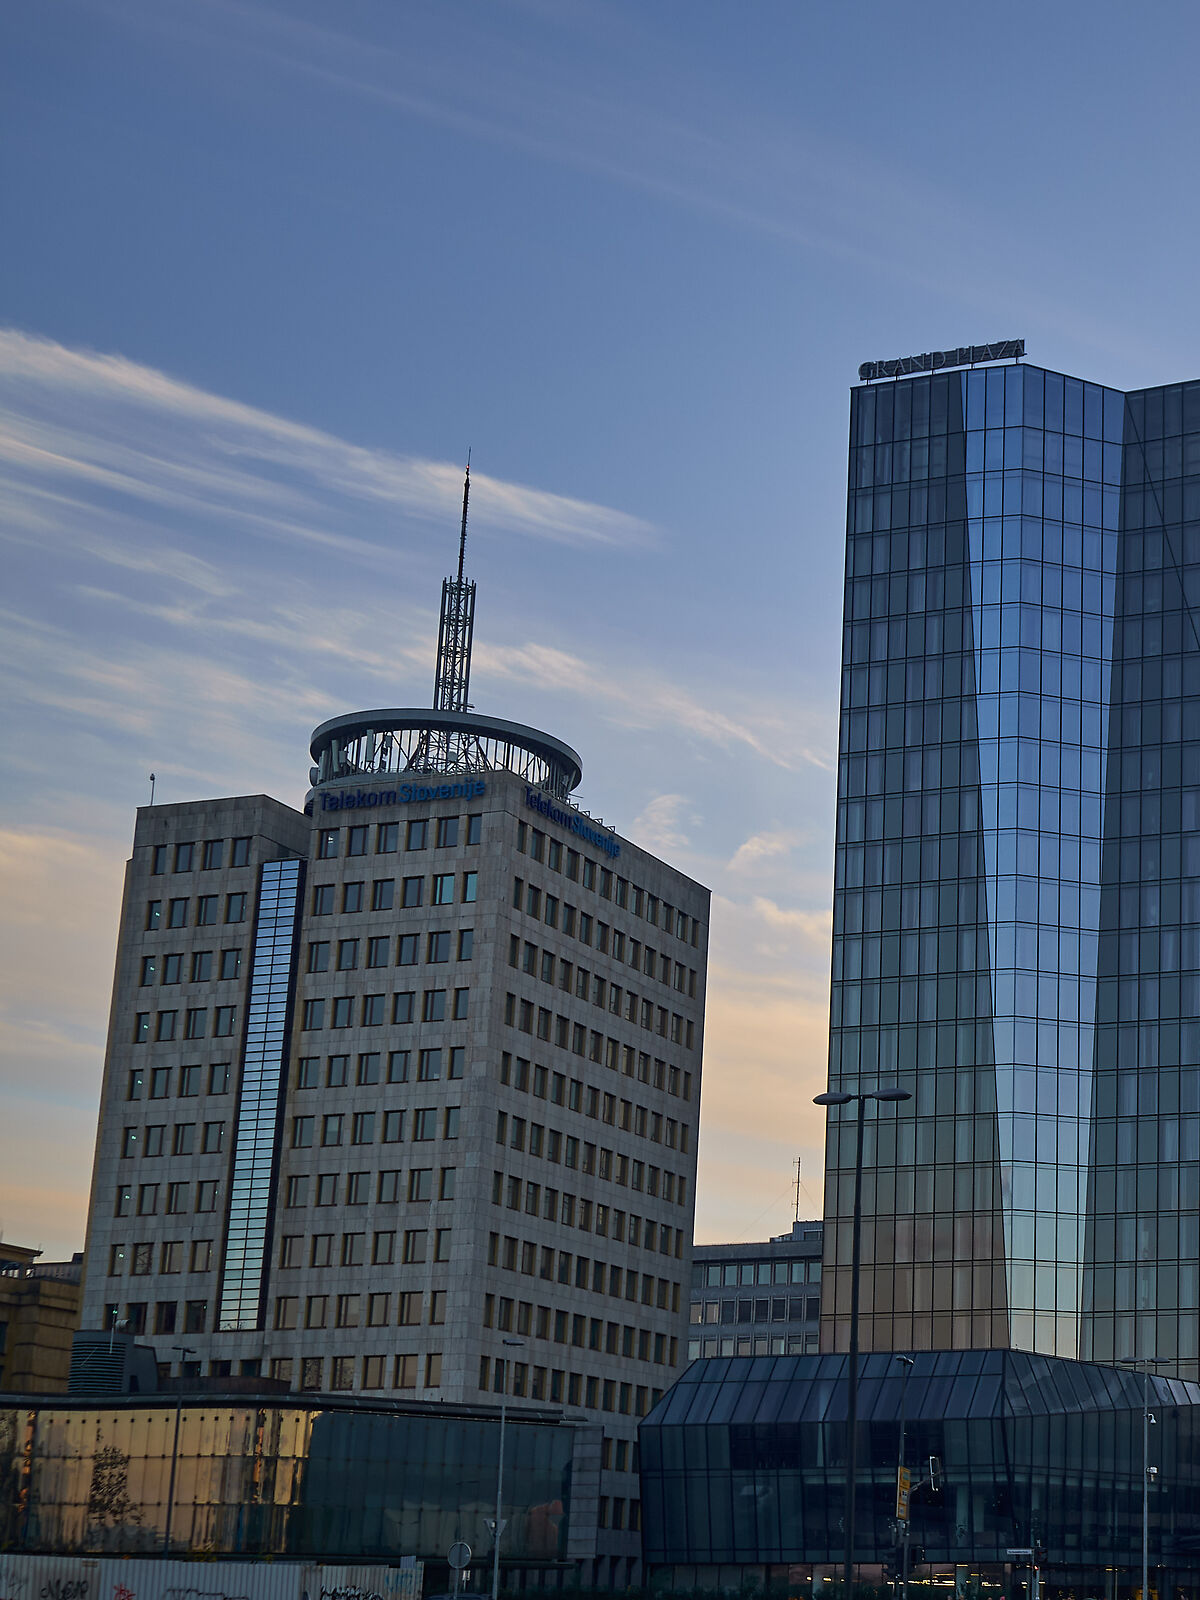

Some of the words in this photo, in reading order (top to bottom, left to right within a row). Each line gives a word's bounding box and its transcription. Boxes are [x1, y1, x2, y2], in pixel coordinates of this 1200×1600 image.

[858, 351, 946, 379] GRAND
[955, 339, 1025, 364] PLAZA
[319, 789, 397, 811] Telekom
[398, 777, 486, 803] Slovenije
[524, 784, 573, 829] Telekom
[572, 815, 621, 859] Slovenije
